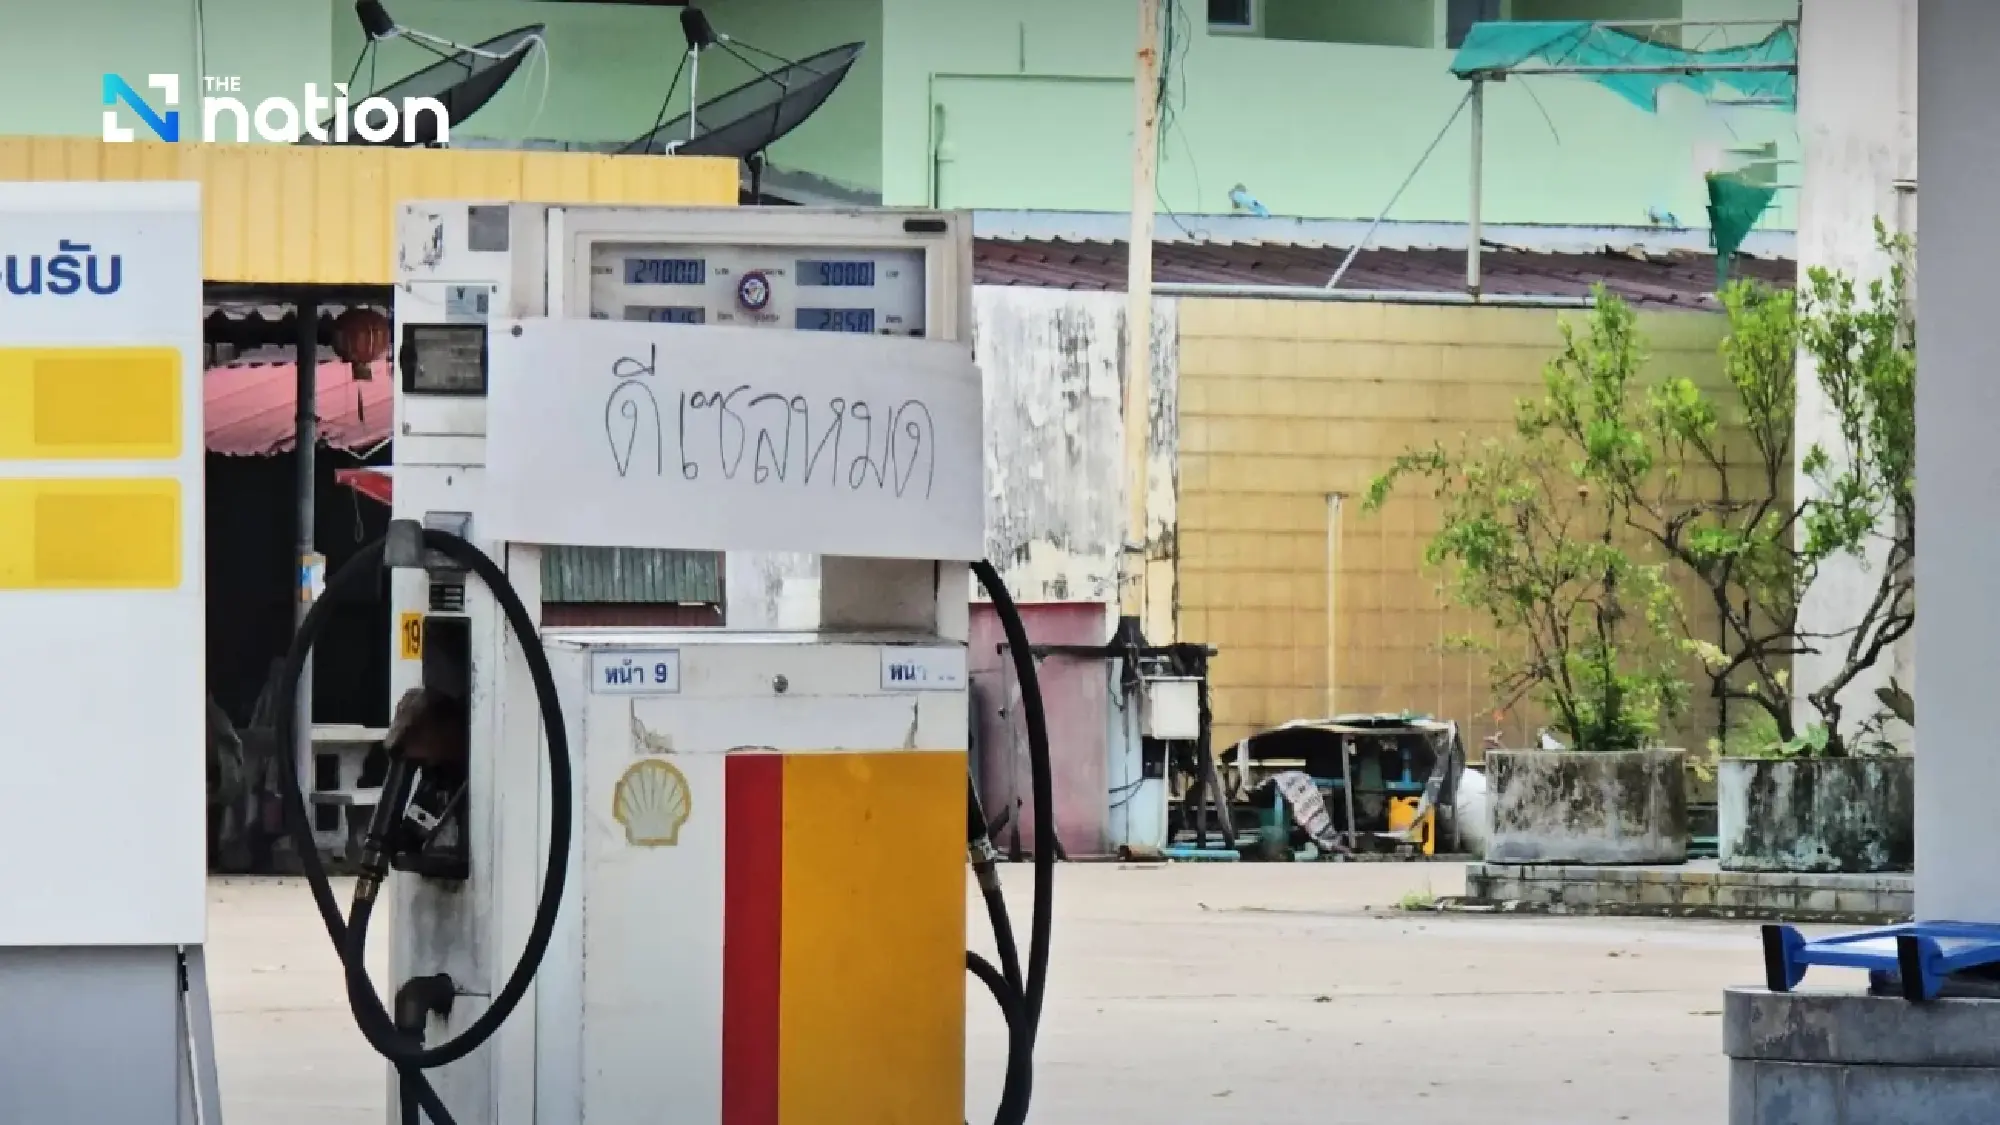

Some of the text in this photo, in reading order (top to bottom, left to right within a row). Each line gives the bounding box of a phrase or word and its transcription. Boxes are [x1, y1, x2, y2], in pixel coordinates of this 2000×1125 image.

[0, 239, 122, 295] นรับ
[605, 343, 935, 500] ดีเซลหมด
[403, 619, 421, 654] 19
[605, 658, 667, 684] หน้า 9
